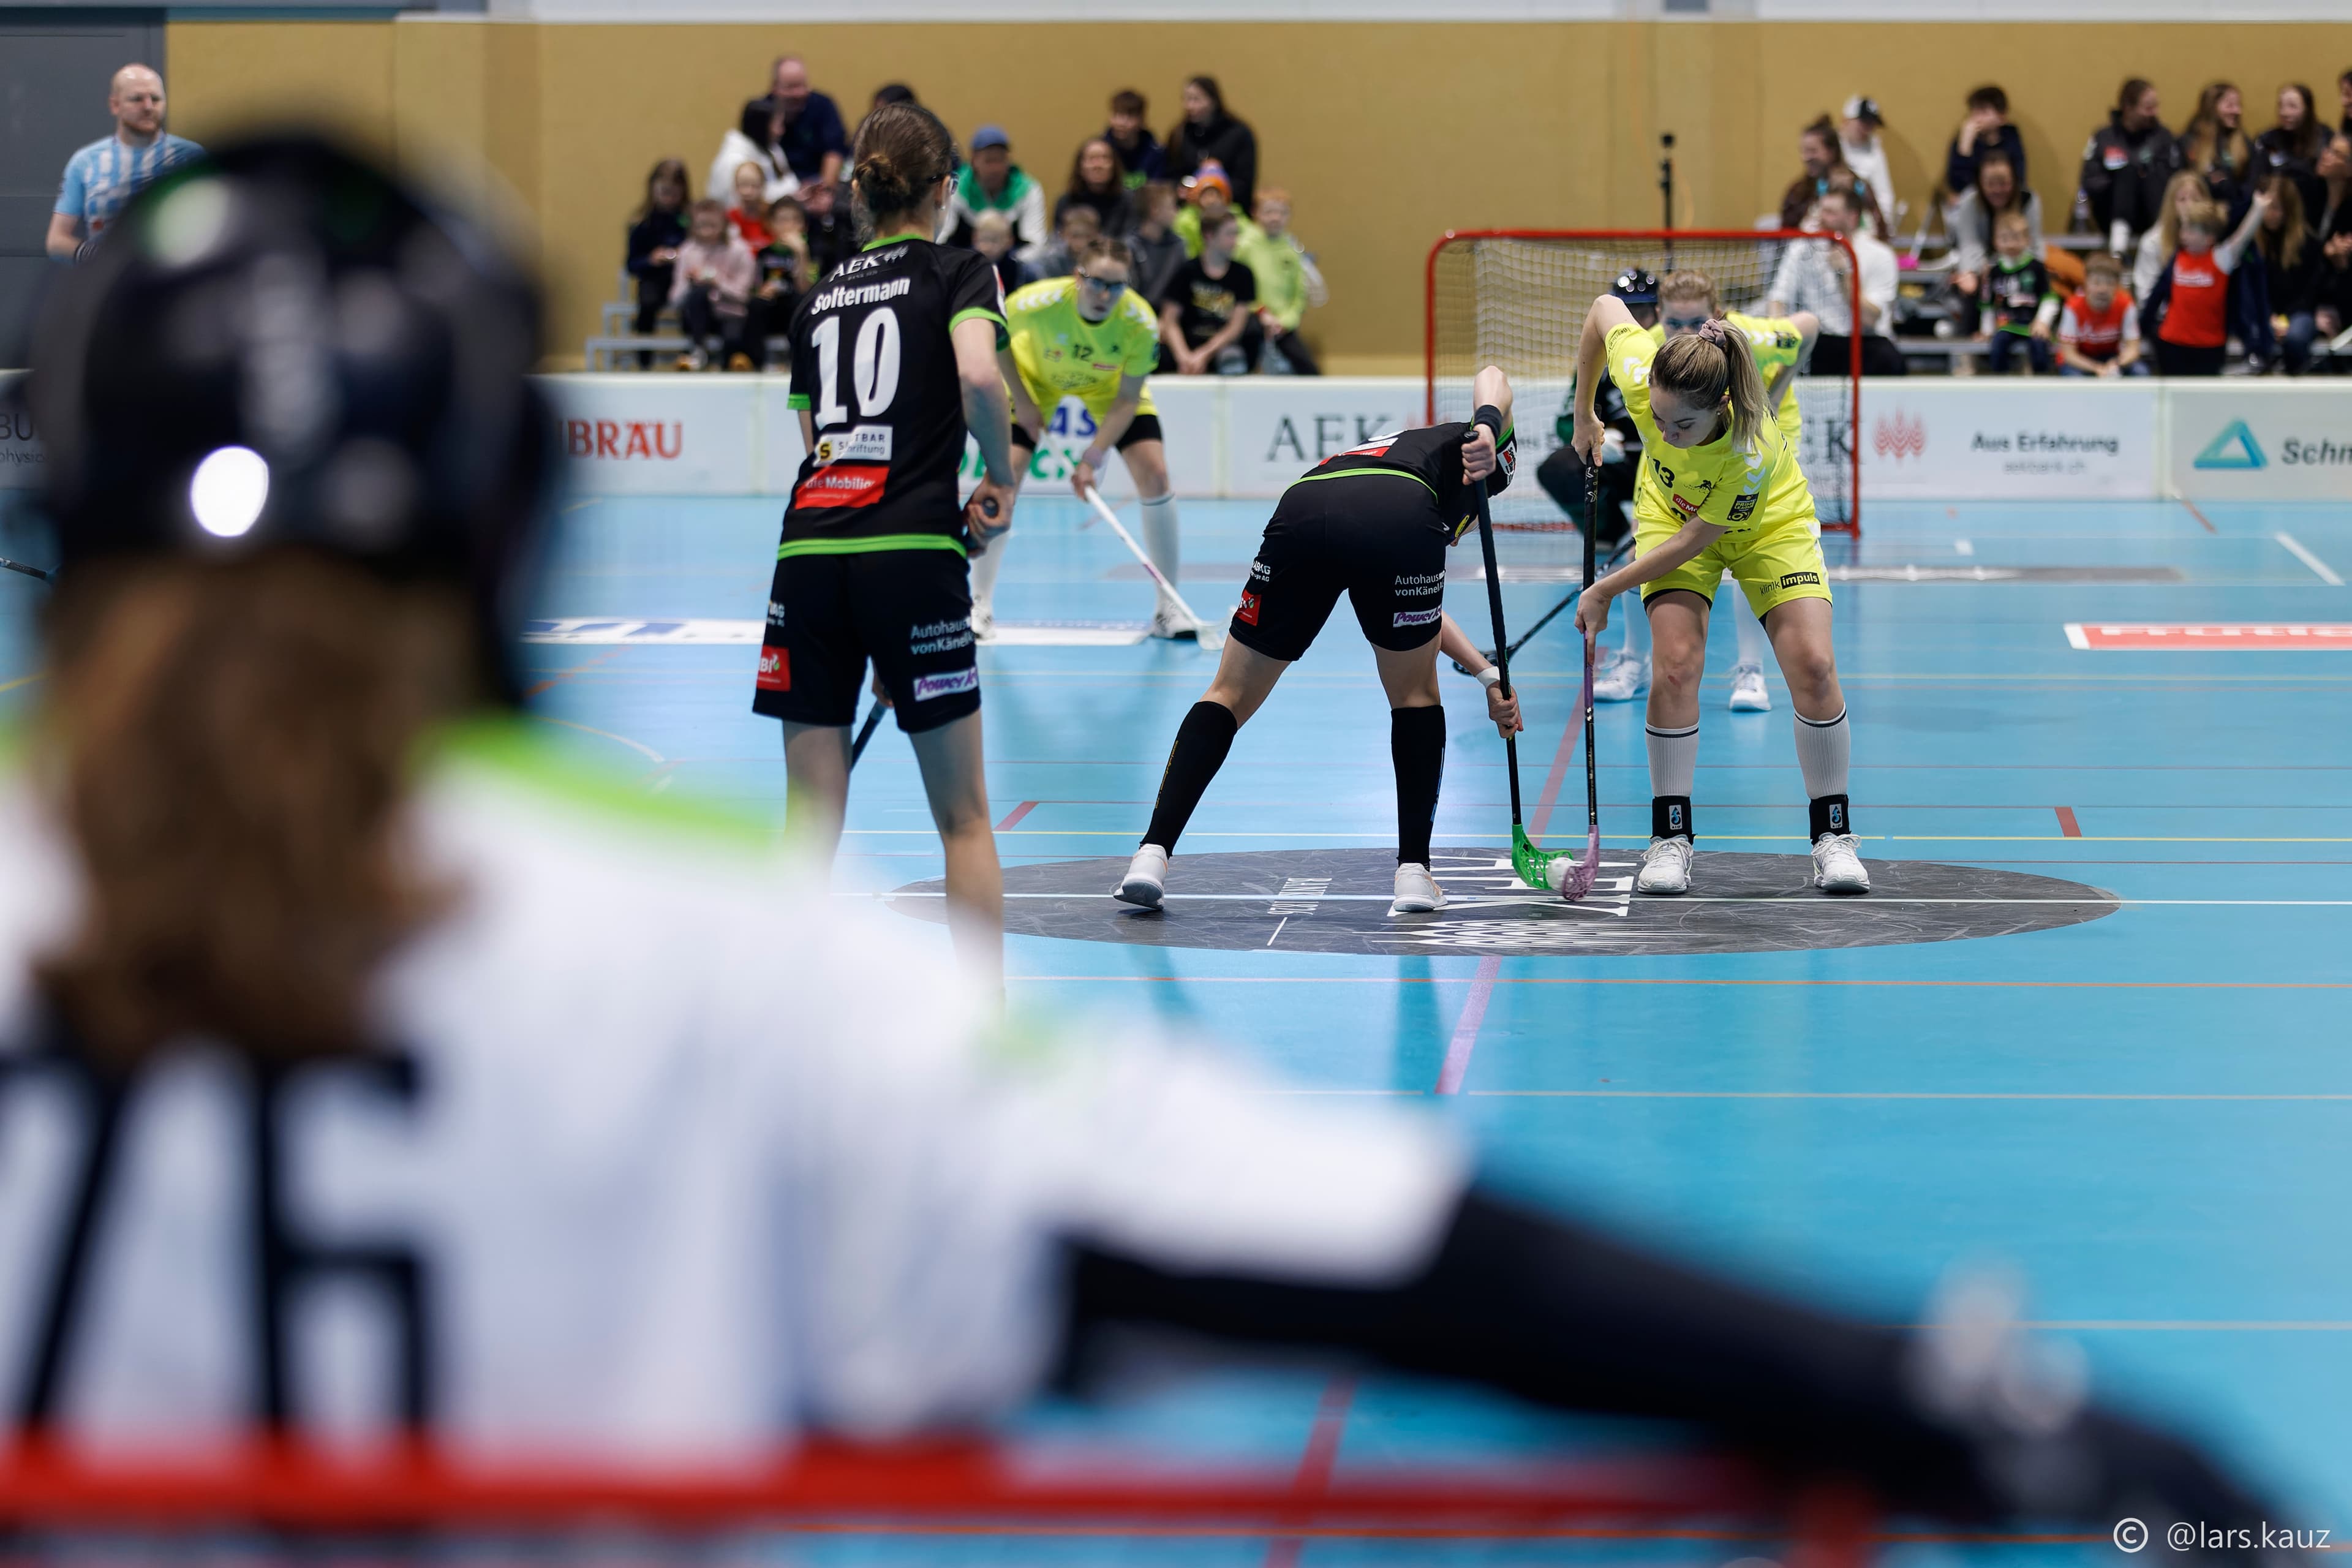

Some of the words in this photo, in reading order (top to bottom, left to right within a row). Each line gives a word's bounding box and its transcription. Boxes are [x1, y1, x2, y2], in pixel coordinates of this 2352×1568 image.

[829, 253, 886, 282] AEK
[811, 277, 911, 315] Soltermann
[1072, 344, 1093, 361] 12
[812, 307, 901, 431] 10
[559, 420, 683, 459] BRÄU
[1970, 432, 2010, 453] Aus
[2017, 430, 2119, 457] Erfahrung
[1395, 573, 1439, 586] Autohaus
[1760, 581, 1780, 596] klinik
[1782, 573, 1818, 586] impuls
[911, 620, 967, 640] Autohaus
